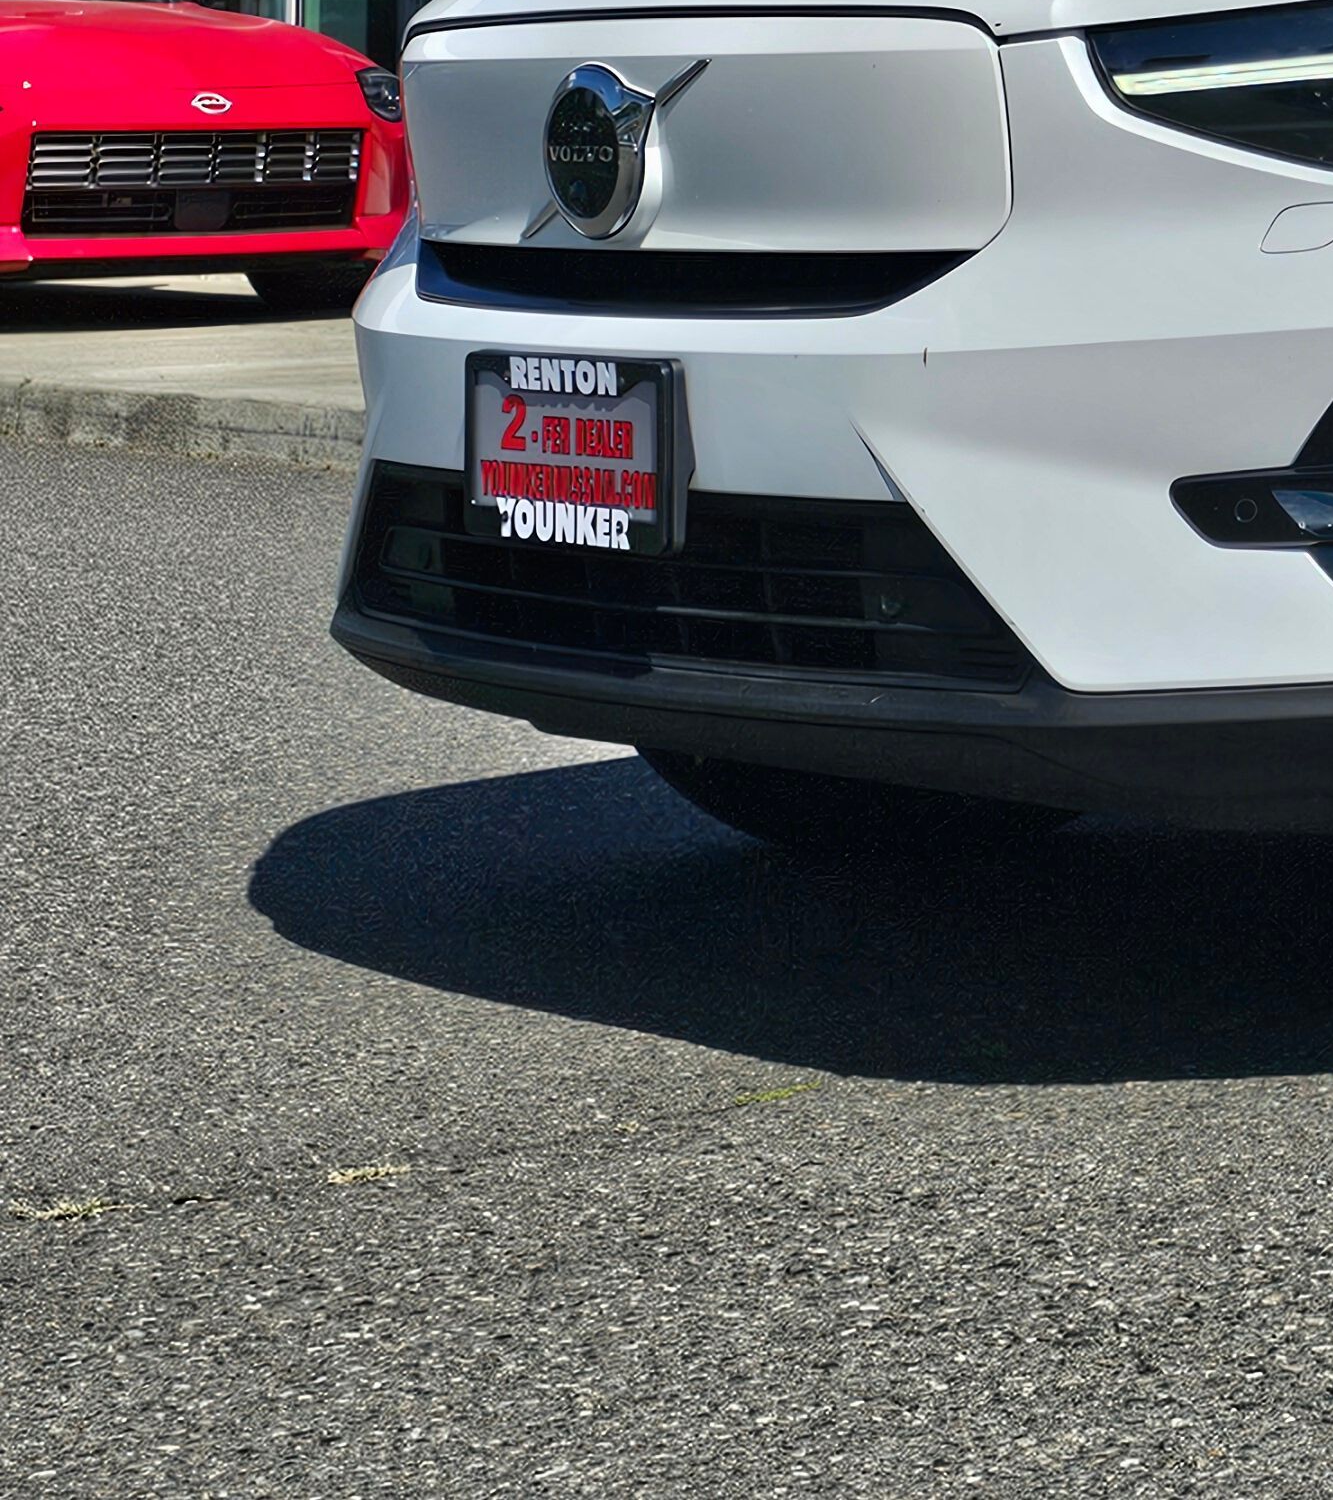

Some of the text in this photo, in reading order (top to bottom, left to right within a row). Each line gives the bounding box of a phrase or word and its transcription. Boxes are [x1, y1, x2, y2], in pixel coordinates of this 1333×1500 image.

[549, 145, 614, 162] VOLVO
[509, 356, 617, 396] RENTON
[575, 418, 633, 460] DEALER
[480, 459, 657, 509] YOUNKERNISSAN.COM
[496, 496, 631, 550] YOUNKER
